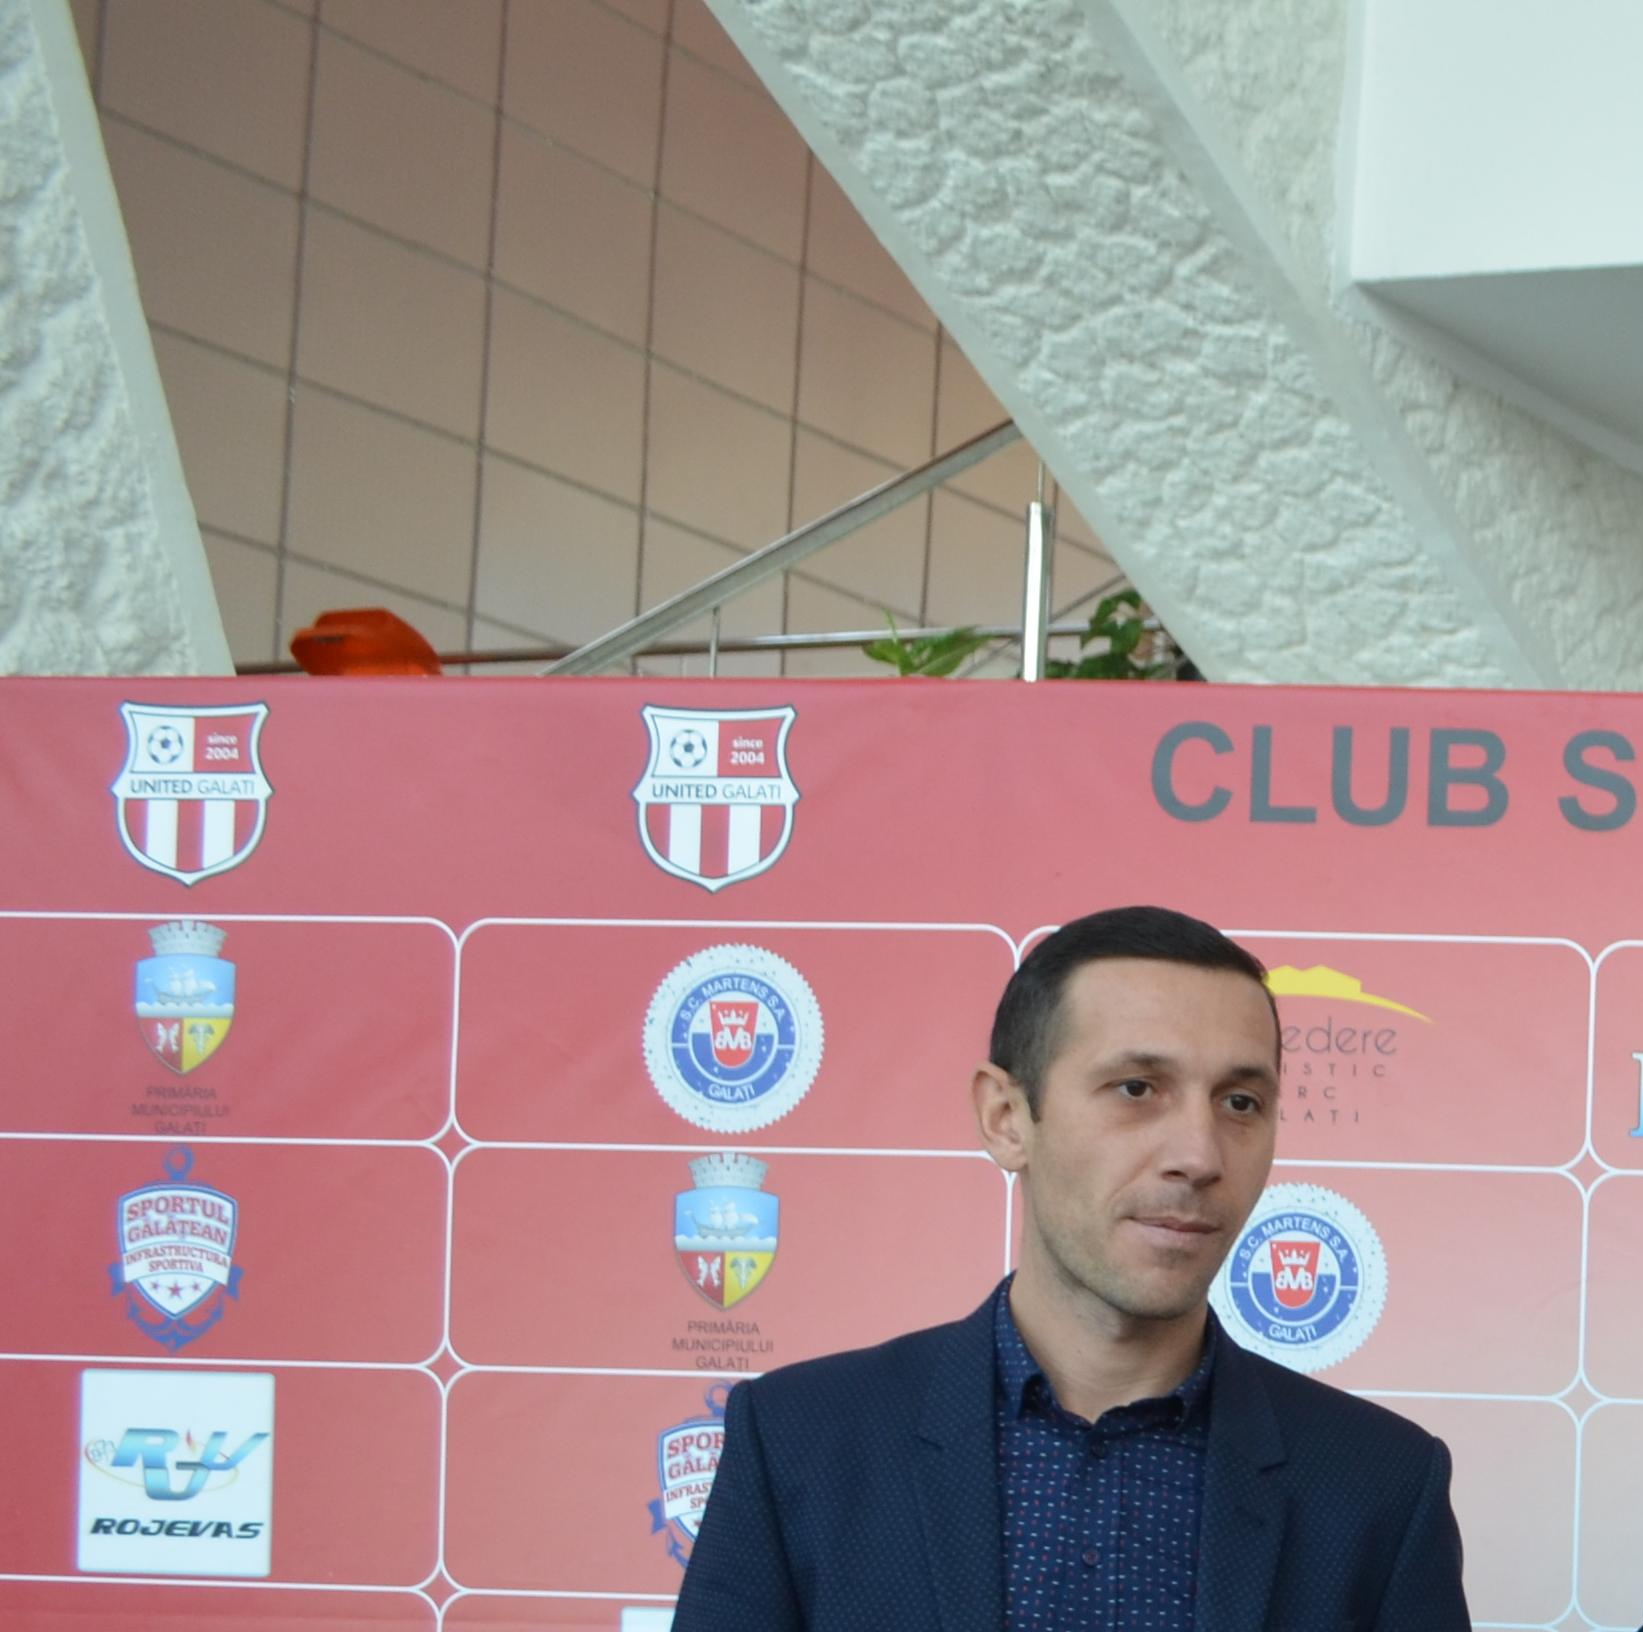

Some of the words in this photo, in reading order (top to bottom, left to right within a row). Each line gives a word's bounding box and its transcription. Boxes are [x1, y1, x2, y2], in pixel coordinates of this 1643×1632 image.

[732, 736, 763, 748] since
[205, 747, 239, 760] 2004
[730, 751, 765, 765] 2004
[1150, 720, 1510, 828] CLUB
[130, 778, 193, 794] UNITED
[197, 779, 255, 795] GALATI
[652, 783, 717, 798] UNITED
[722, 784, 781, 799] GALATI
[701, 977, 769, 1000] MARTENS
[1281, 1015, 1398, 1055] edere
[1283, 1063, 1386, 1077] ISTIC
[126, 1195, 229, 1225] SPORTUL
[1260, 1216, 1331, 1240] MARTENS
[687, 1320, 760, 1335] PRIMĂRIA
[671, 1337, 775, 1353] MUNICIPIULUI
[667, 1431, 725, 1459] SPOR
[90, 1517, 264, 1540] ROJEVAS
